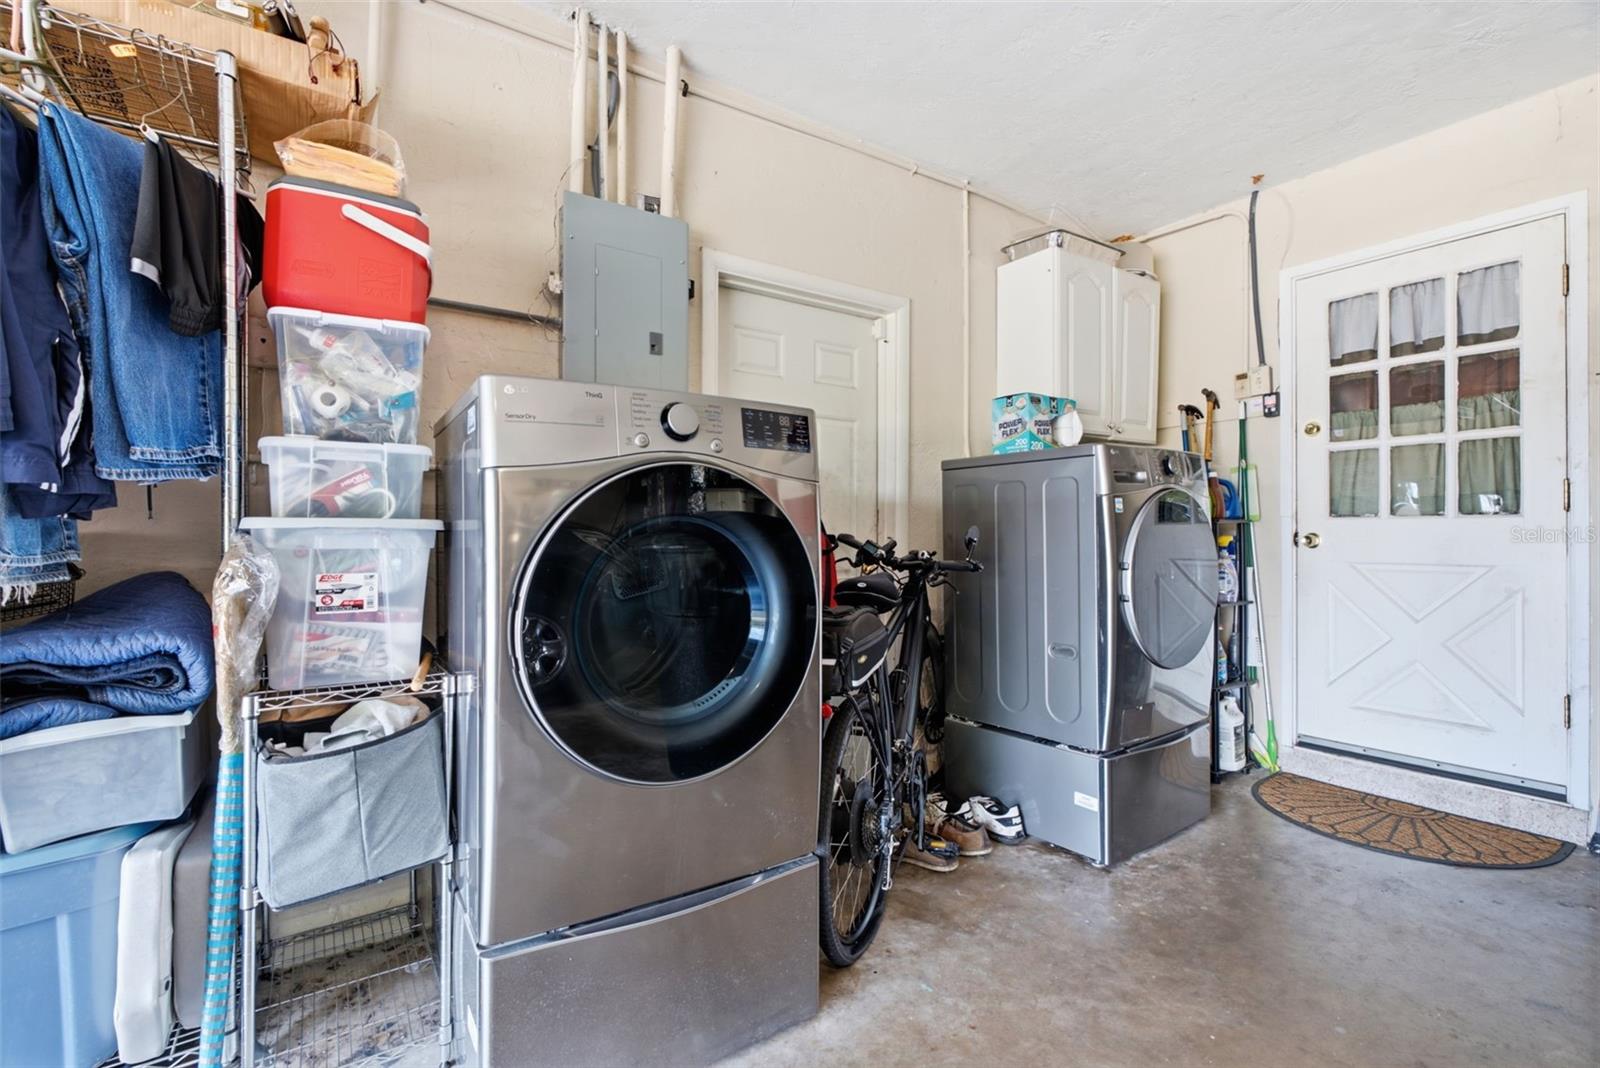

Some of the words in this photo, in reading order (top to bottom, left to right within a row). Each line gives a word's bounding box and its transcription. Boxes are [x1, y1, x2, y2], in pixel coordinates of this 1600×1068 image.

[585, 391, 603, 399] ThinQ
[999, 418, 1022, 430] POWER
[1001, 427, 1019, 438] FLEX
[1037, 428, 1051, 436] FLEX
[1031, 441, 1044, 450] 200
